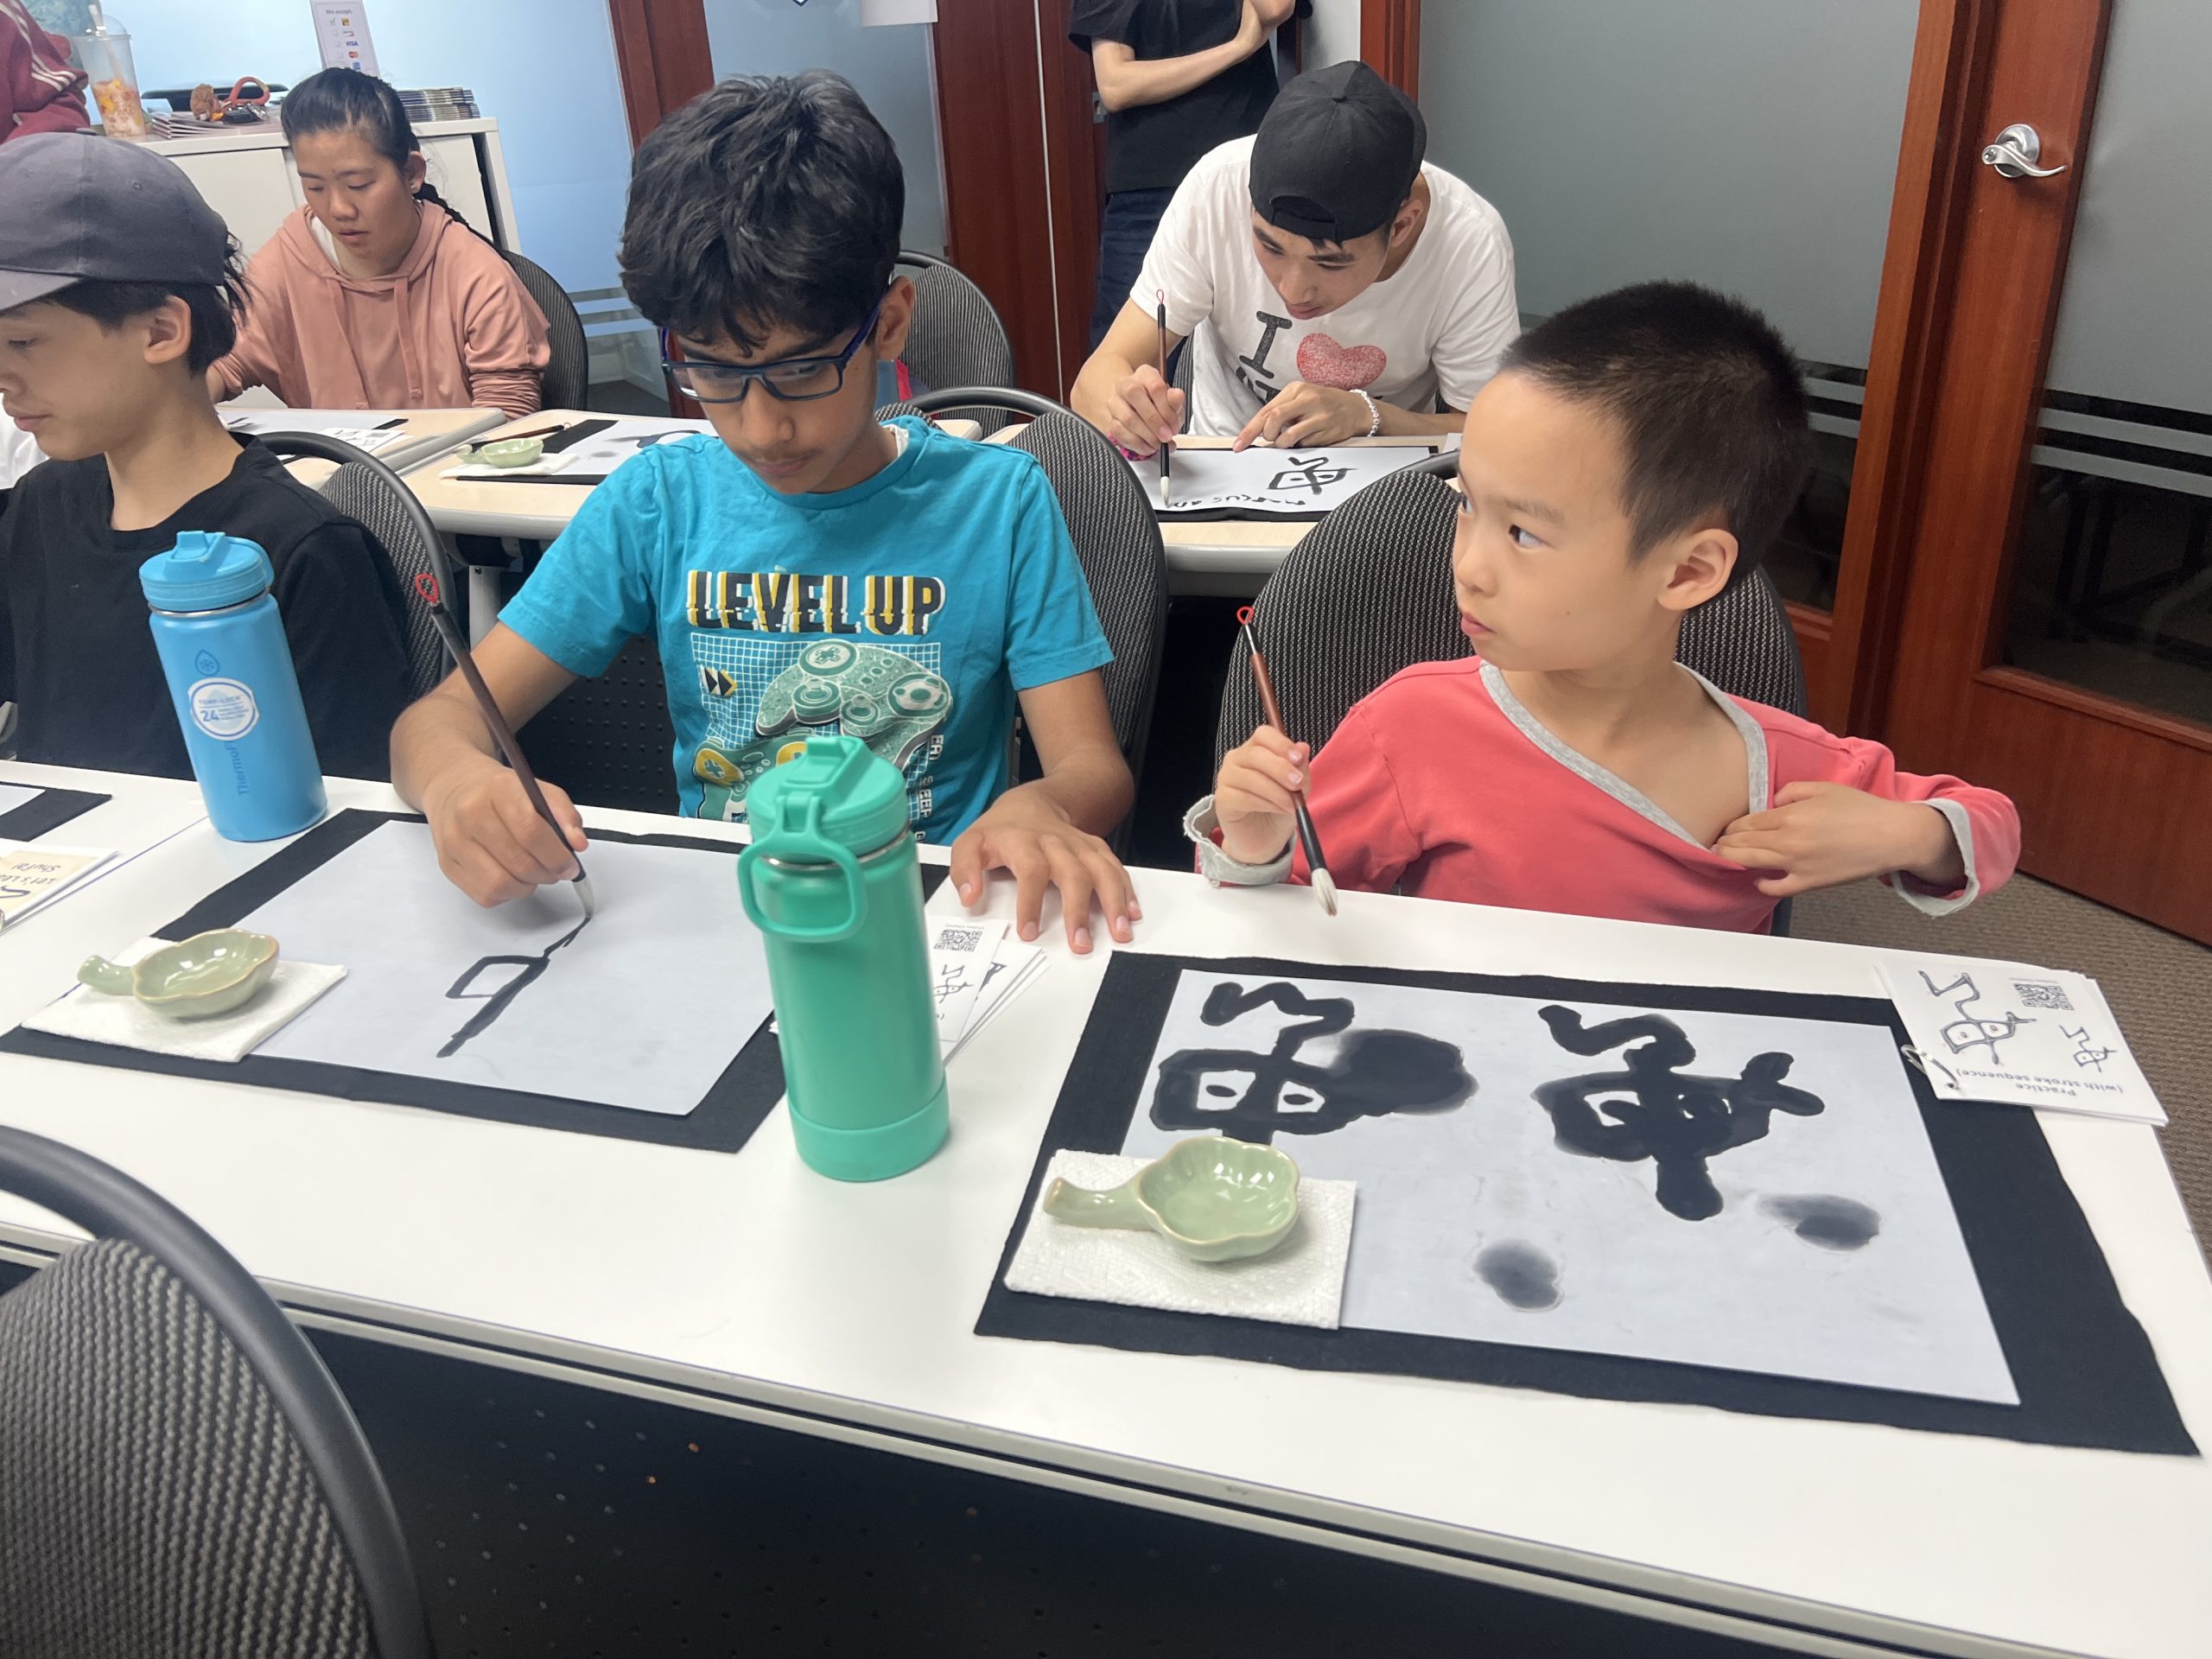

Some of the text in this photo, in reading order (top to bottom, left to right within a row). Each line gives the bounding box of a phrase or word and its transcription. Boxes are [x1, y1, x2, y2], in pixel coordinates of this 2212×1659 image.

[1238, 310, 1293, 379] I
[687, 569, 946, 637] LEVEL UP
[200, 709, 219, 721] 24
[918, 774, 935, 819] SEEP
[1955, 1068, 2124, 1095] (with stroke sequence)
[2015, 1082, 2077, 1097] Practice
